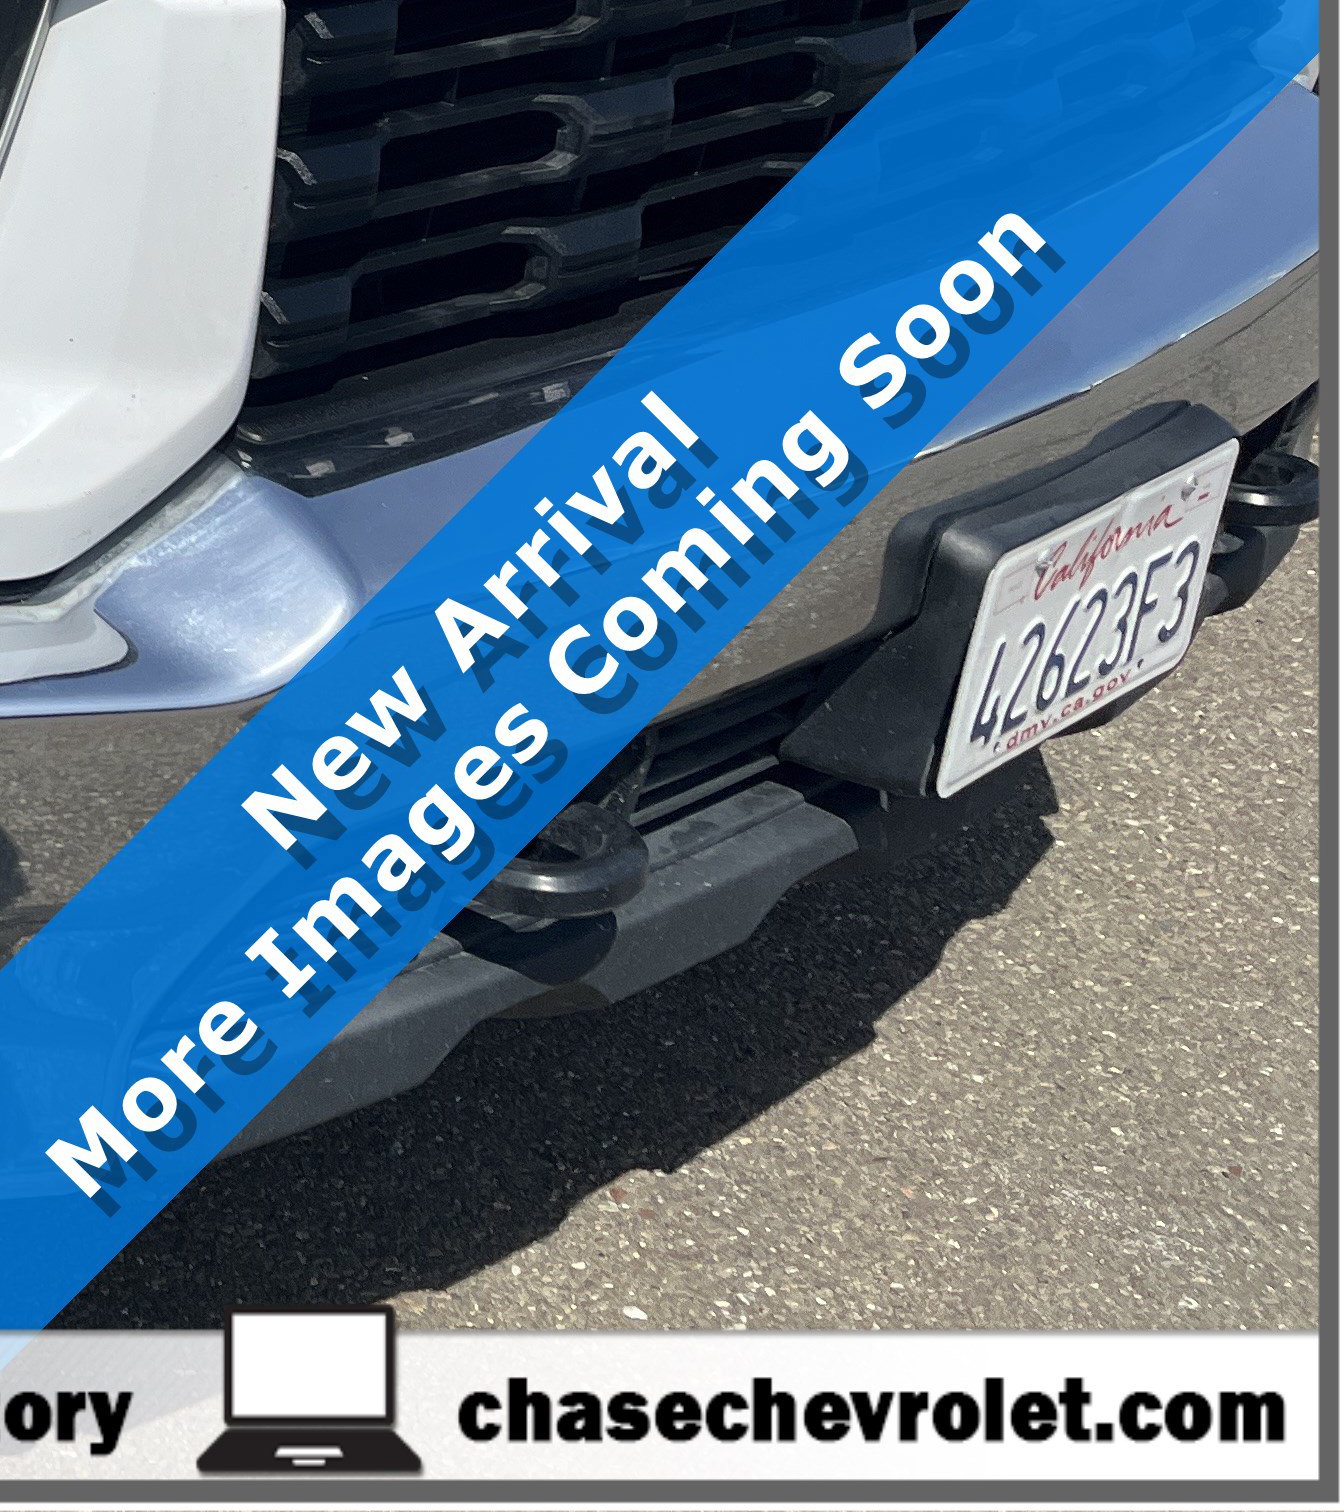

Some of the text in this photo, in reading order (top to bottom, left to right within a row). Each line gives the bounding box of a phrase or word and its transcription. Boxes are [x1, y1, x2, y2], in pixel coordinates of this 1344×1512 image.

[1033, 504, 1184, 601] California
[969, 540, 1201, 747] 42623F3
[1005, 668, 1132, 752] dmv.ca.gov
